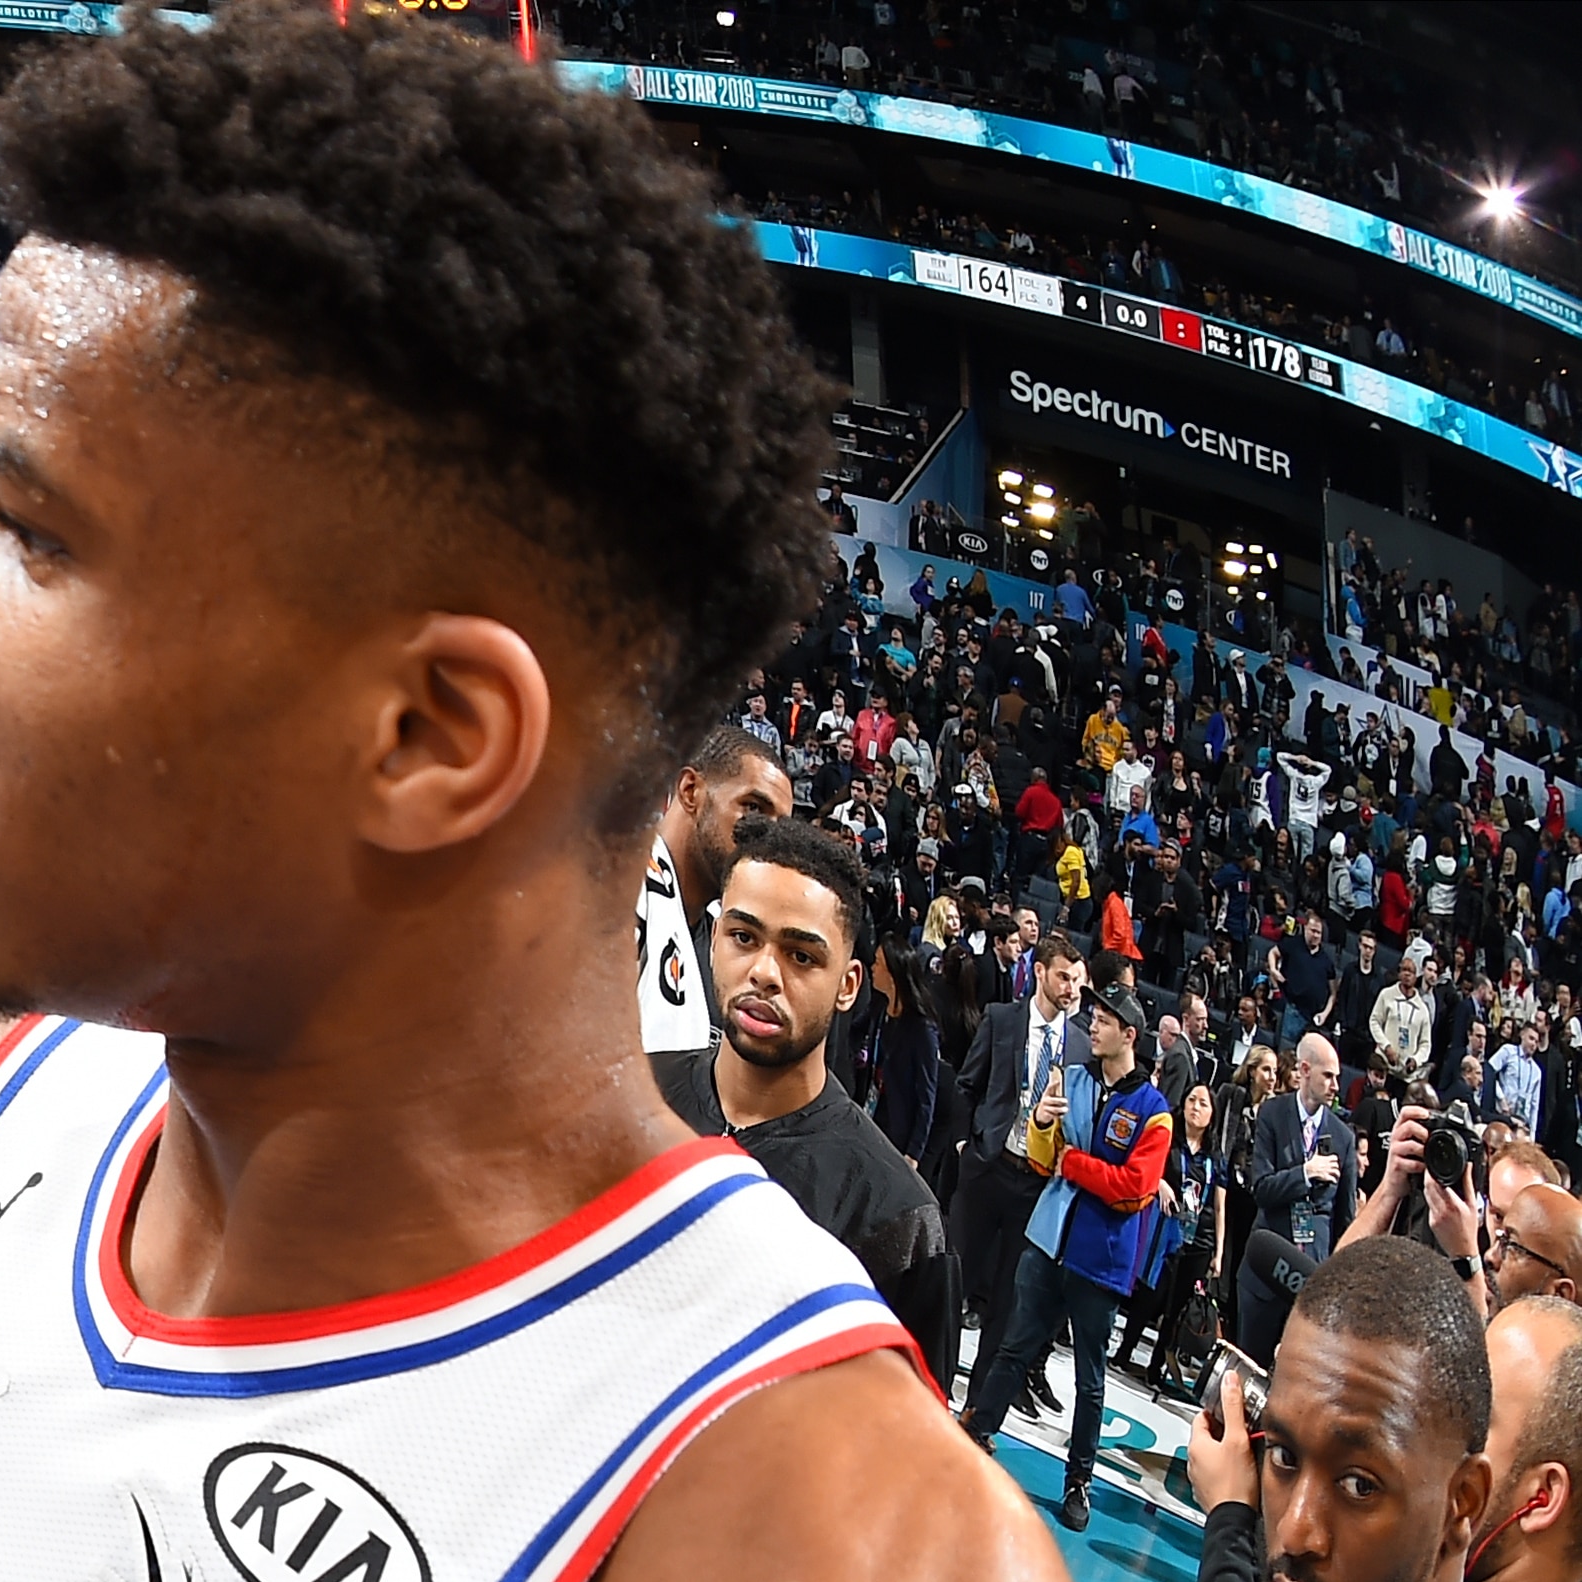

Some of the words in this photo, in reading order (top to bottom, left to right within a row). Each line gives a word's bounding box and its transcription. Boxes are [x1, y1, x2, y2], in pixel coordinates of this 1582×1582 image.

[718, 77, 755, 109] 2019
[760, 90, 827, 108] CHARLOTTE
[962, 264, 1008, 297] 164
[1076, 295, 1087, 310] 4
[1116, 305, 1147, 328] 0.0
[1253, 337, 1301, 378] 178
[1010, 370, 1164, 438] Spectrum
[1181, 422, 1291, 478] CENTER
[962, 536, 984, 549] KIA
[1031, 555, 1048, 565] TNT
[1029, 591, 1045, 610] 117
[1166, 594, 1184, 605] TNT
